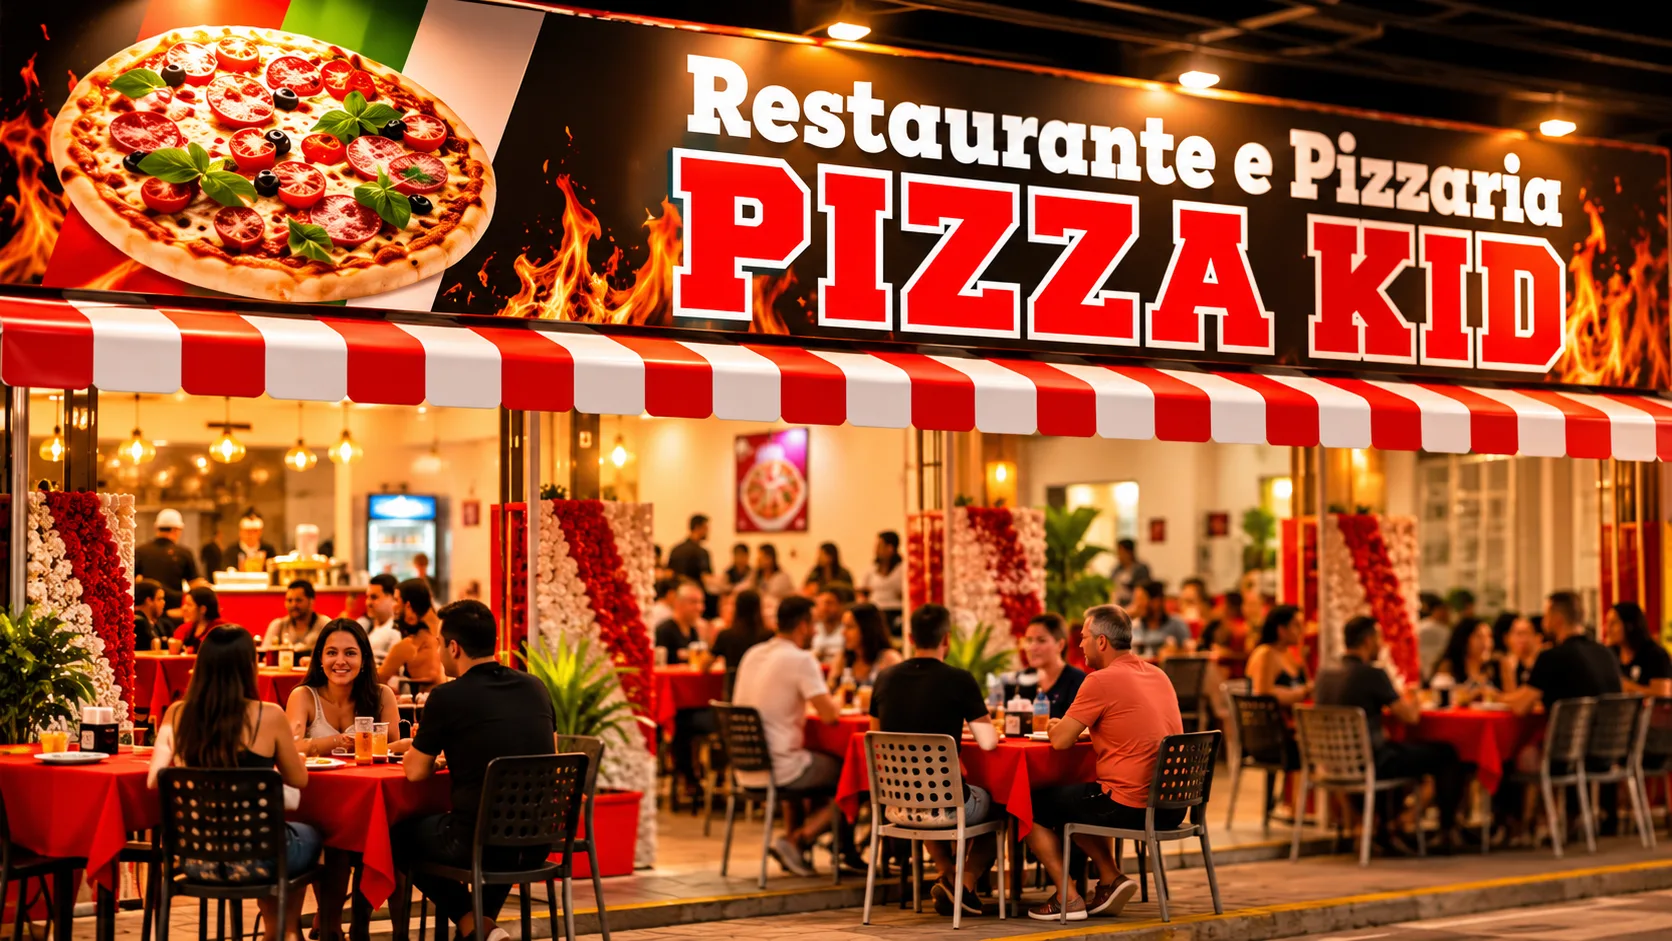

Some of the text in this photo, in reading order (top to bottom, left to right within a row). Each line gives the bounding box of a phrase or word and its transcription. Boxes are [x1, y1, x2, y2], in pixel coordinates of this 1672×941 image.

[686, 54, 1563, 228] Restaurante e Pizzaria
[672, 147, 1567, 373] PIZZA KID
